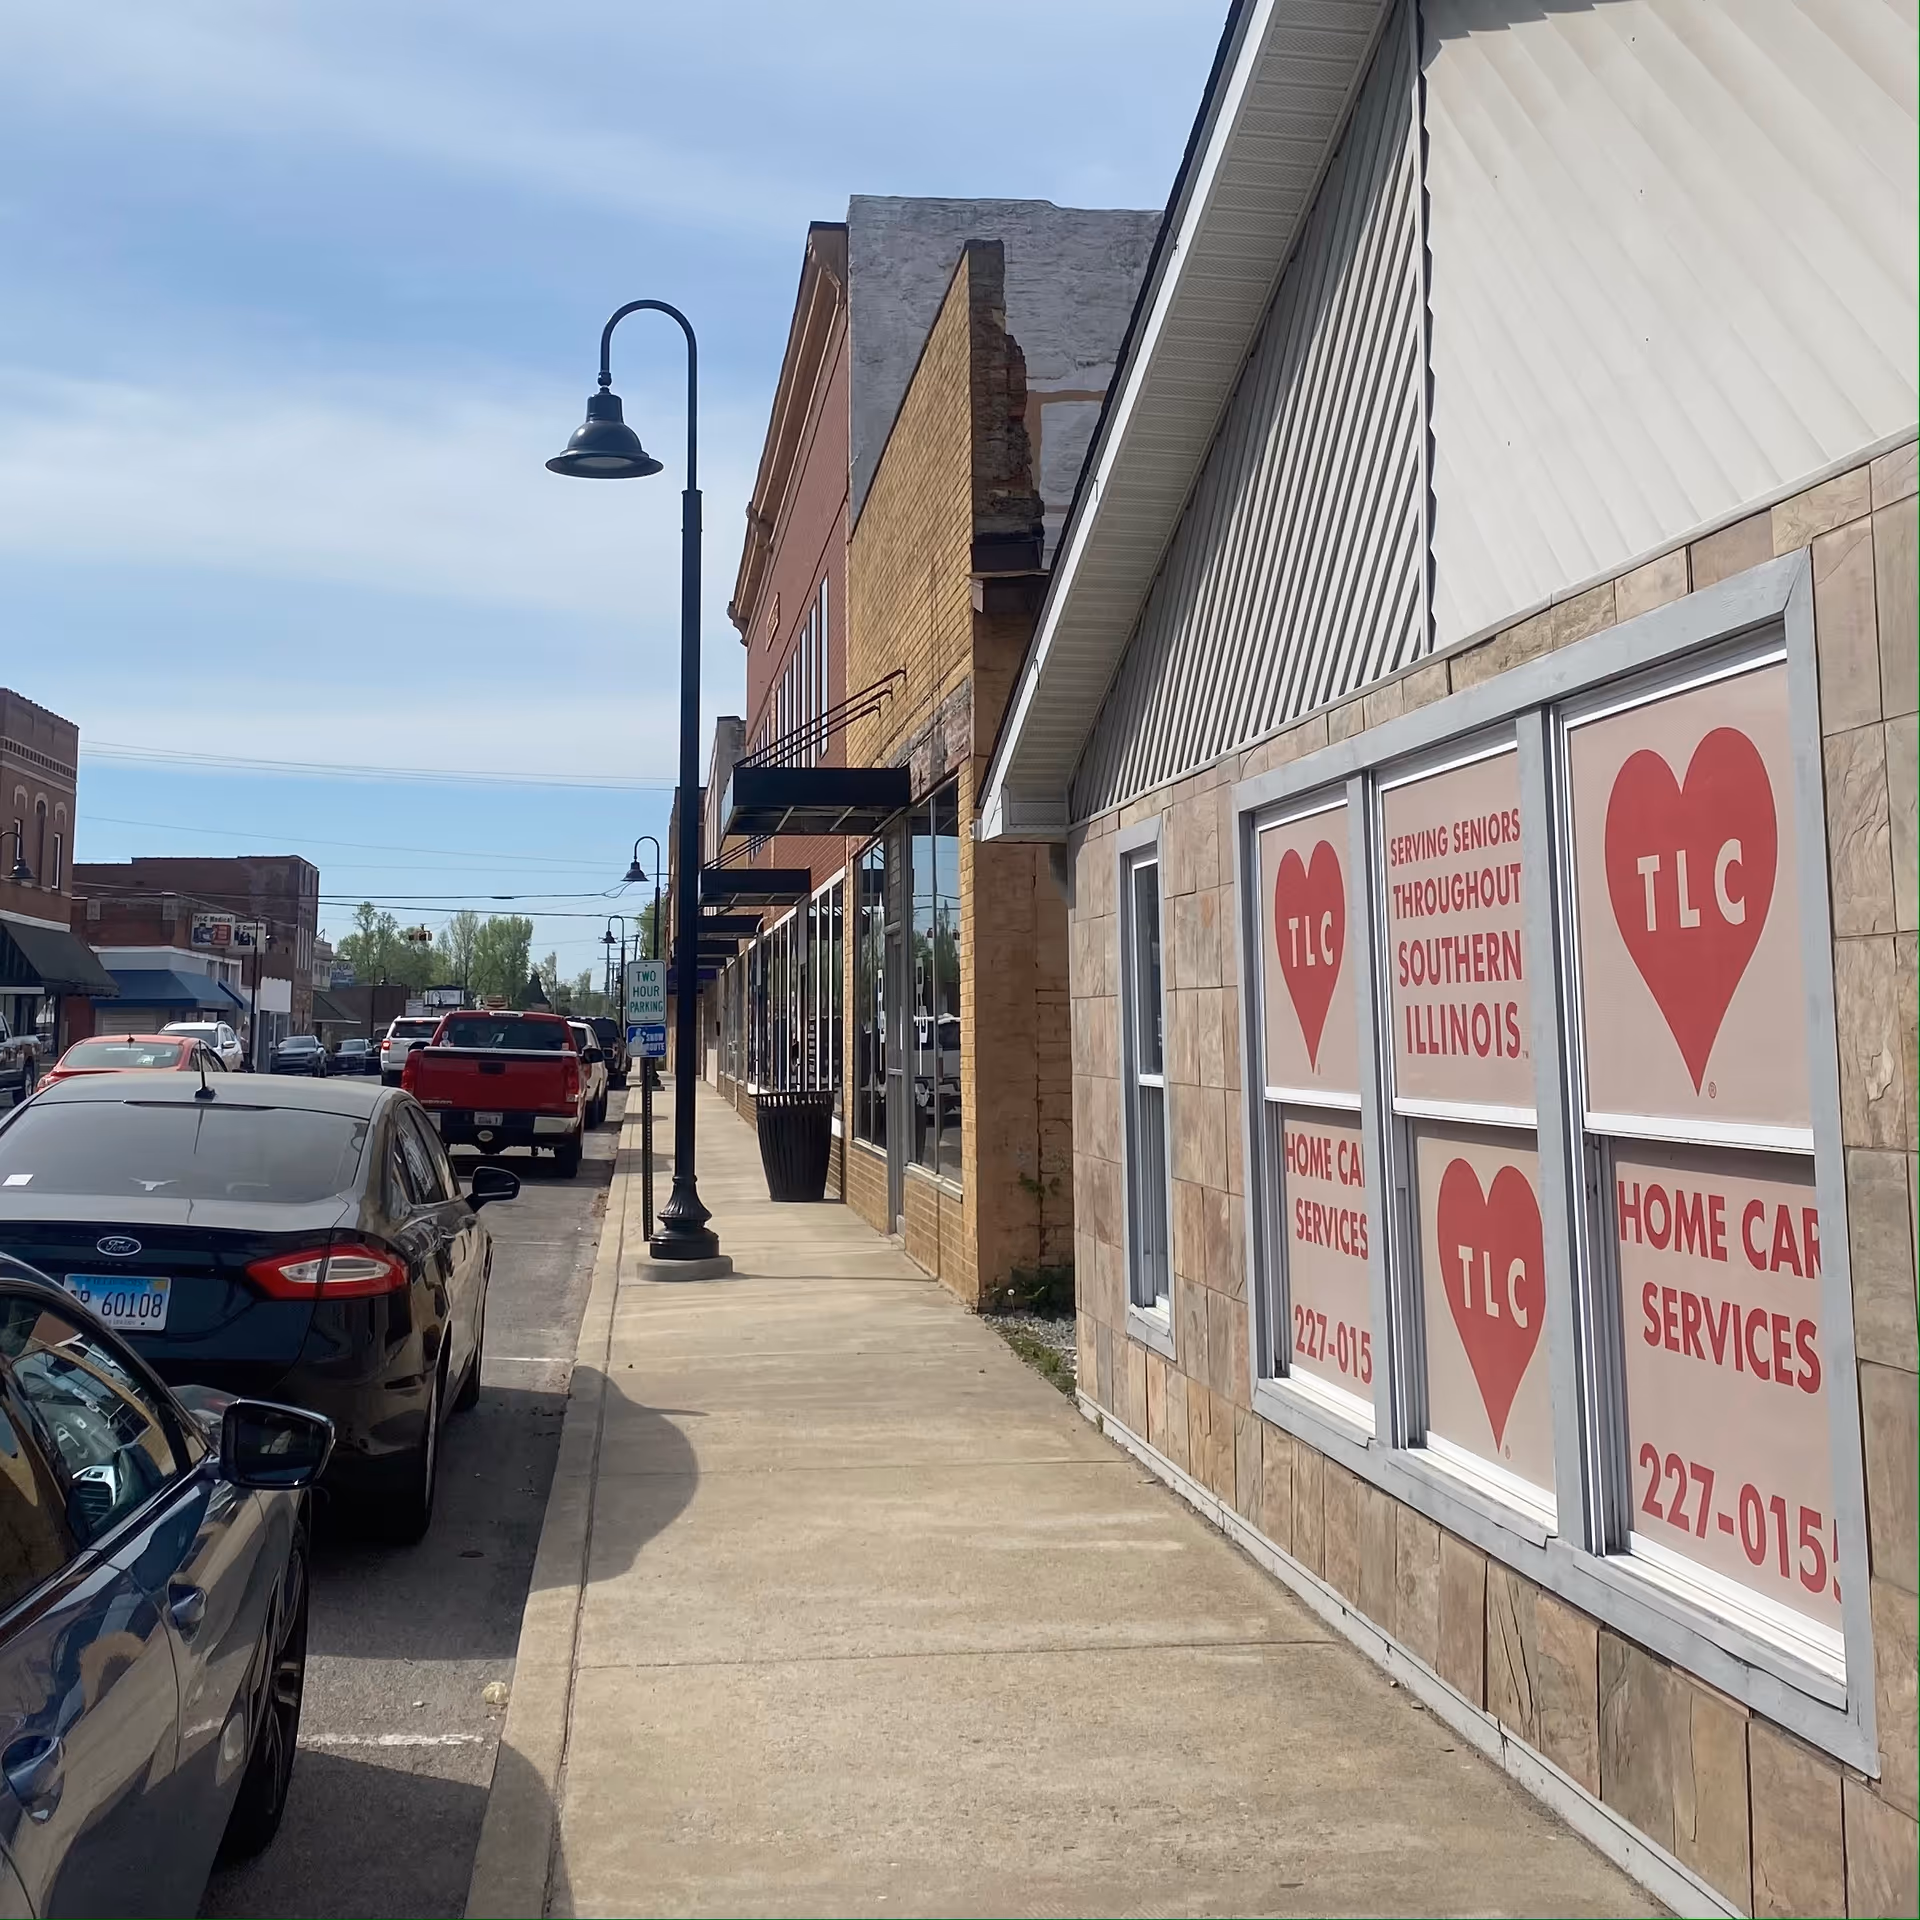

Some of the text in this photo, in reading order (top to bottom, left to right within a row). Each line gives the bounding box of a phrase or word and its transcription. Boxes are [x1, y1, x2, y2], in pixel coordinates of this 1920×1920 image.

[1391, 808, 1520, 867] SERVING SENIORS
[1393, 863, 1521, 919] THROUGHOUT
[1637, 838, 1746, 931] TLC
[1288, 911, 1334, 967] TLC
[1398, 930, 1522, 987] SOUTHERN
[633, 986, 660, 997] HOUR
[636, 971, 656, 982] TWO
[630, 1001, 663, 1013] PARKING
[1405, 1002, 1521, 1059] ILLINOIS
[646, 1033, 664, 1041] SNOW
[1284, 1132, 1366, 1188] HOME CA
[106, 1240, 131, 1251] Ford
[1296, 1198, 1368, 1260] SERVICES
[1618, 1181, 1728, 1262] HOME
[101, 1292, 163, 1318] 60108
[1458, 1244, 1528, 1329] TLC
[1642, 1281, 1822, 1394] SERVICES
